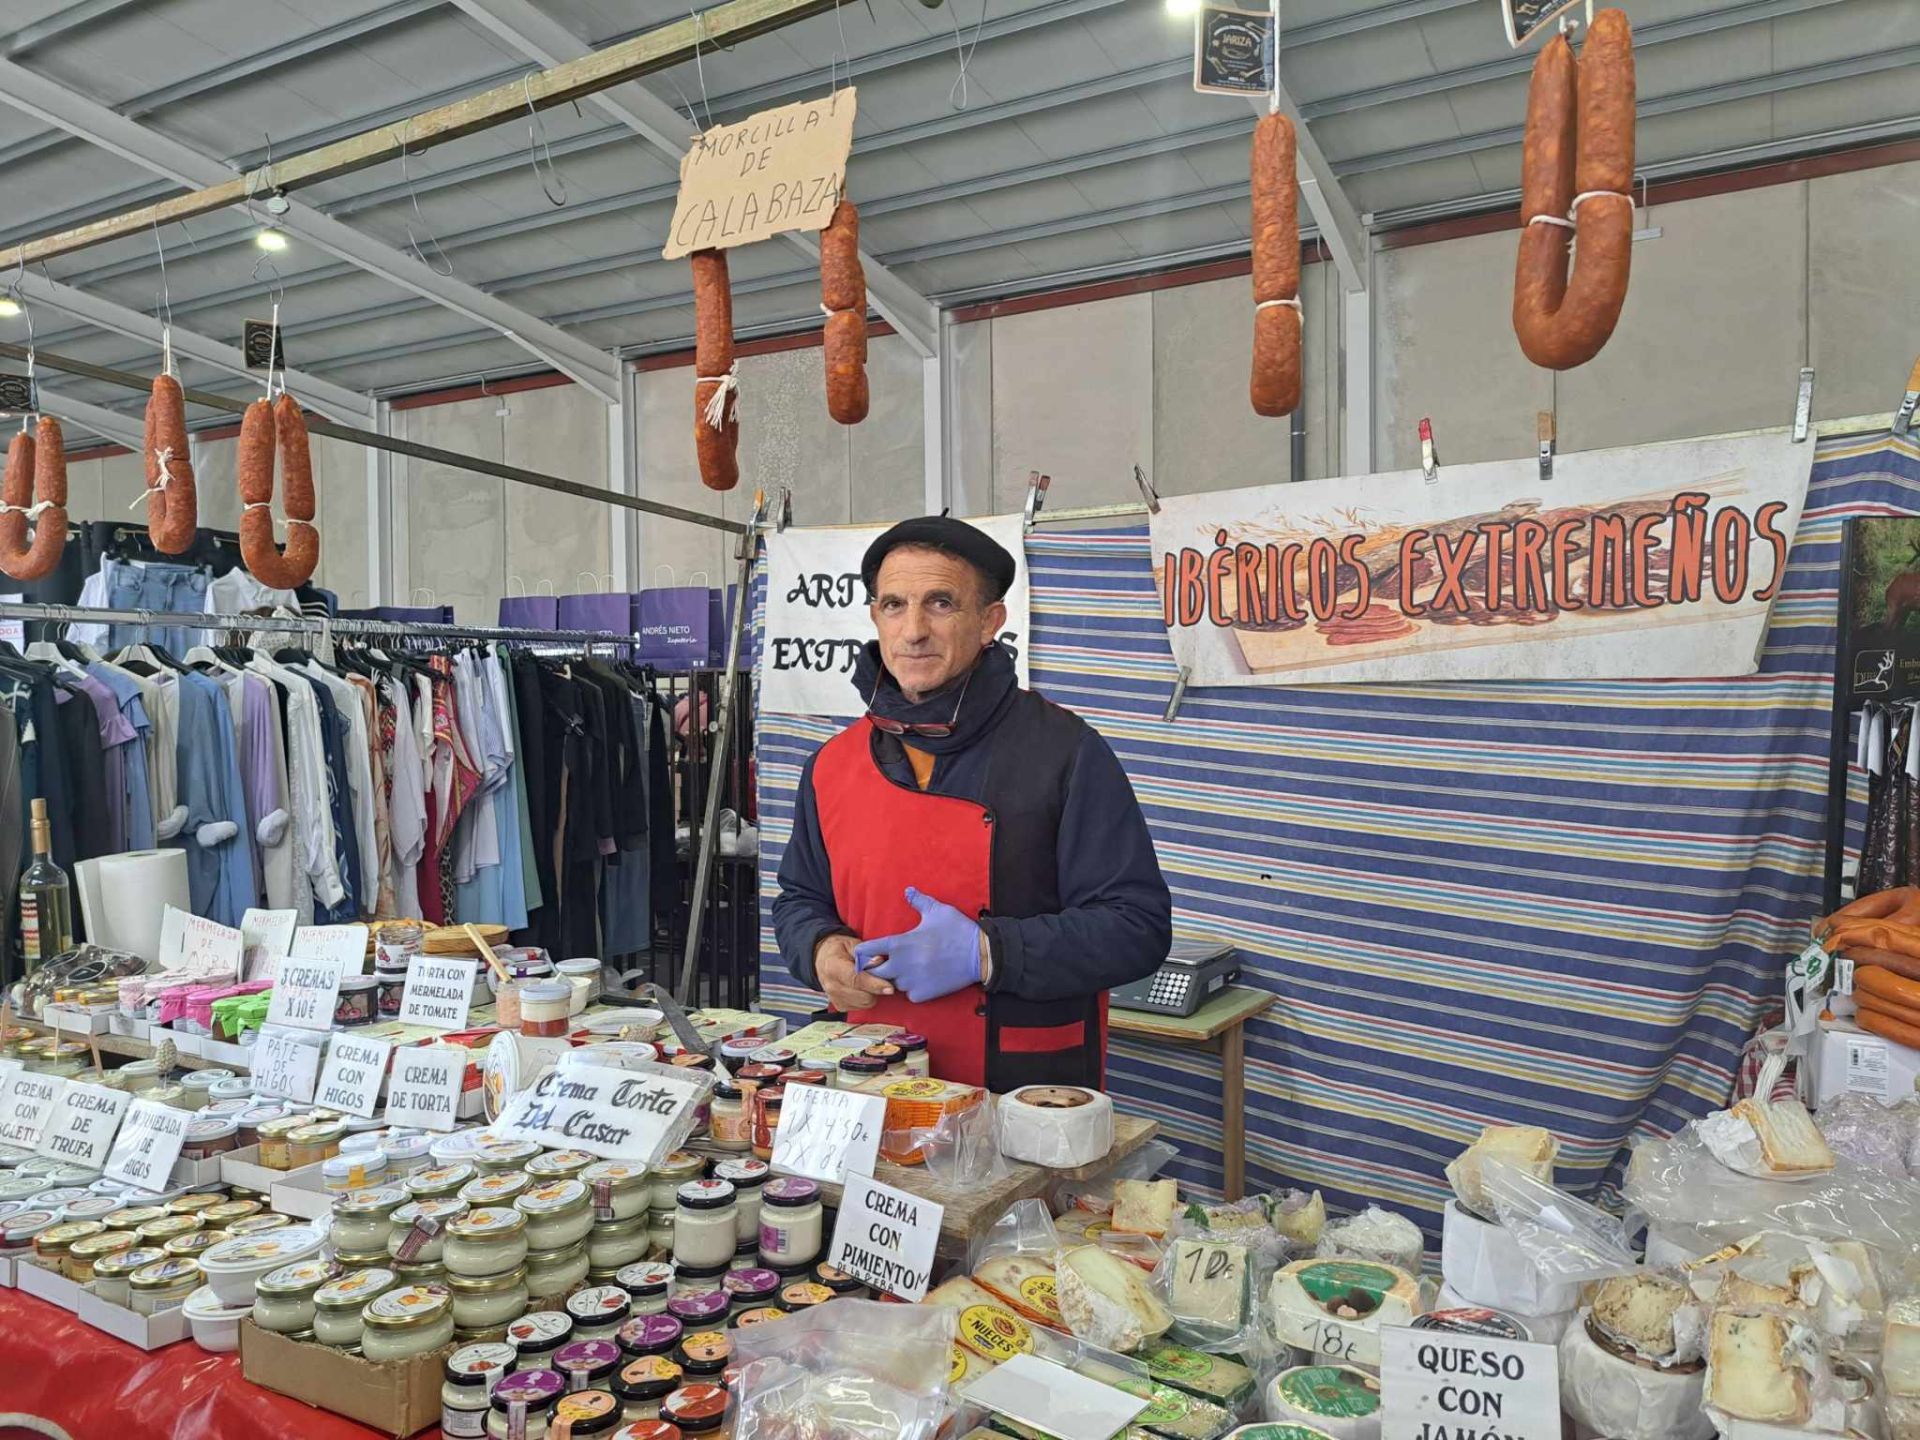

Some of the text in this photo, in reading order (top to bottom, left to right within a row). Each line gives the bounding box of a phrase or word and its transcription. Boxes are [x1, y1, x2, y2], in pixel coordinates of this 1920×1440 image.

[695, 110, 820, 166] MORCILLA
[740, 146, 772, 177] DE
[675, 172, 839, 247] CALABAZA
[1164, 491, 1788, 629] IBÉRICOS EXTREMEÑOS
[642, 624, 690, 635] ANDRÉS NIETO
[290, 968, 335, 990] CREMAS
[447, 968, 466, 981] CON
[409, 984, 464, 1001] MERMELADA
[408, 1003, 458, 1020] DE TOMATE
[336, 1044, 379, 1066] CREMA
[273, 1060, 287, 1074] DE
[337, 1067, 365, 1085] CON
[404, 1066, 448, 1086] CREMA
[14, 1081, 53, 1100] CREMA
[255, 1069, 295, 1097] HIGOS
[535, 1070, 679, 1116] Crema Torta
[67, 1092, 117, 1116] CREMA
[323, 1087, 365, 1109] HIGOS
[391, 1091, 451, 1113] DE TORTA
[15, 1103, 40, 1120] CON
[70, 1116, 93, 1134] DE
[513, 1101, 632, 1146] Del Casar
[51, 1135, 94, 1159] TRUFA
[139, 1137, 155, 1155] DE
[122, 1158, 152, 1179] HIGOS
[865, 1189, 918, 1227] CREMA
[869, 1223, 902, 1252] CON
[841, 1242, 929, 1291] PIMIENTON
[970, 1319, 1014, 1352] NUECES
[1417, 1344, 1525, 1381] QUESO
[1438, 1385, 1504, 1419] CON
[1415, 1422, 1526, 1440] JAM
